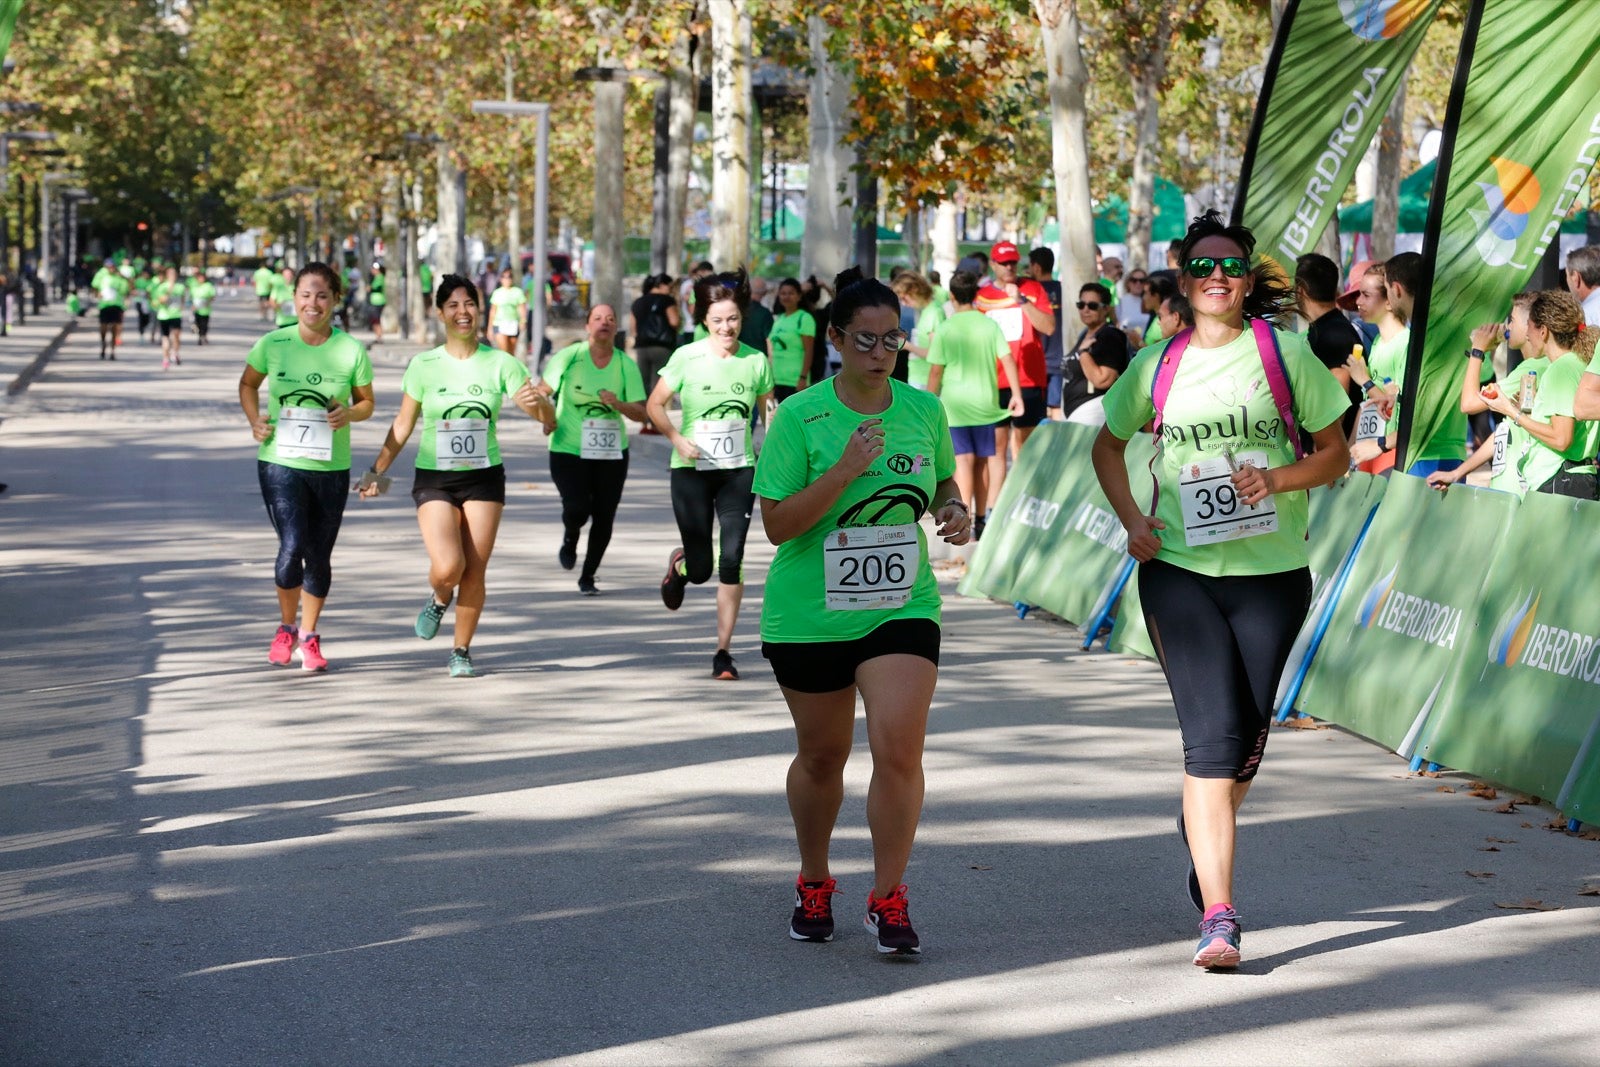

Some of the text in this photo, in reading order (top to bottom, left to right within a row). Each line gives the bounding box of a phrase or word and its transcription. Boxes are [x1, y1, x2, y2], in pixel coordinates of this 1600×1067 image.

[1278, 66, 1388, 262] IBERDROLA
[297, 424, 310, 443] 7
[451, 435, 475, 455] 60
[588, 432, 616, 448] 332
[1162, 405, 1280, 451] mpulsa
[711, 436, 734, 455] 70
[1195, 484, 1256, 520] 39
[839, 553, 906, 587] 206
[1376, 589, 1464, 651] IBERDROLA
